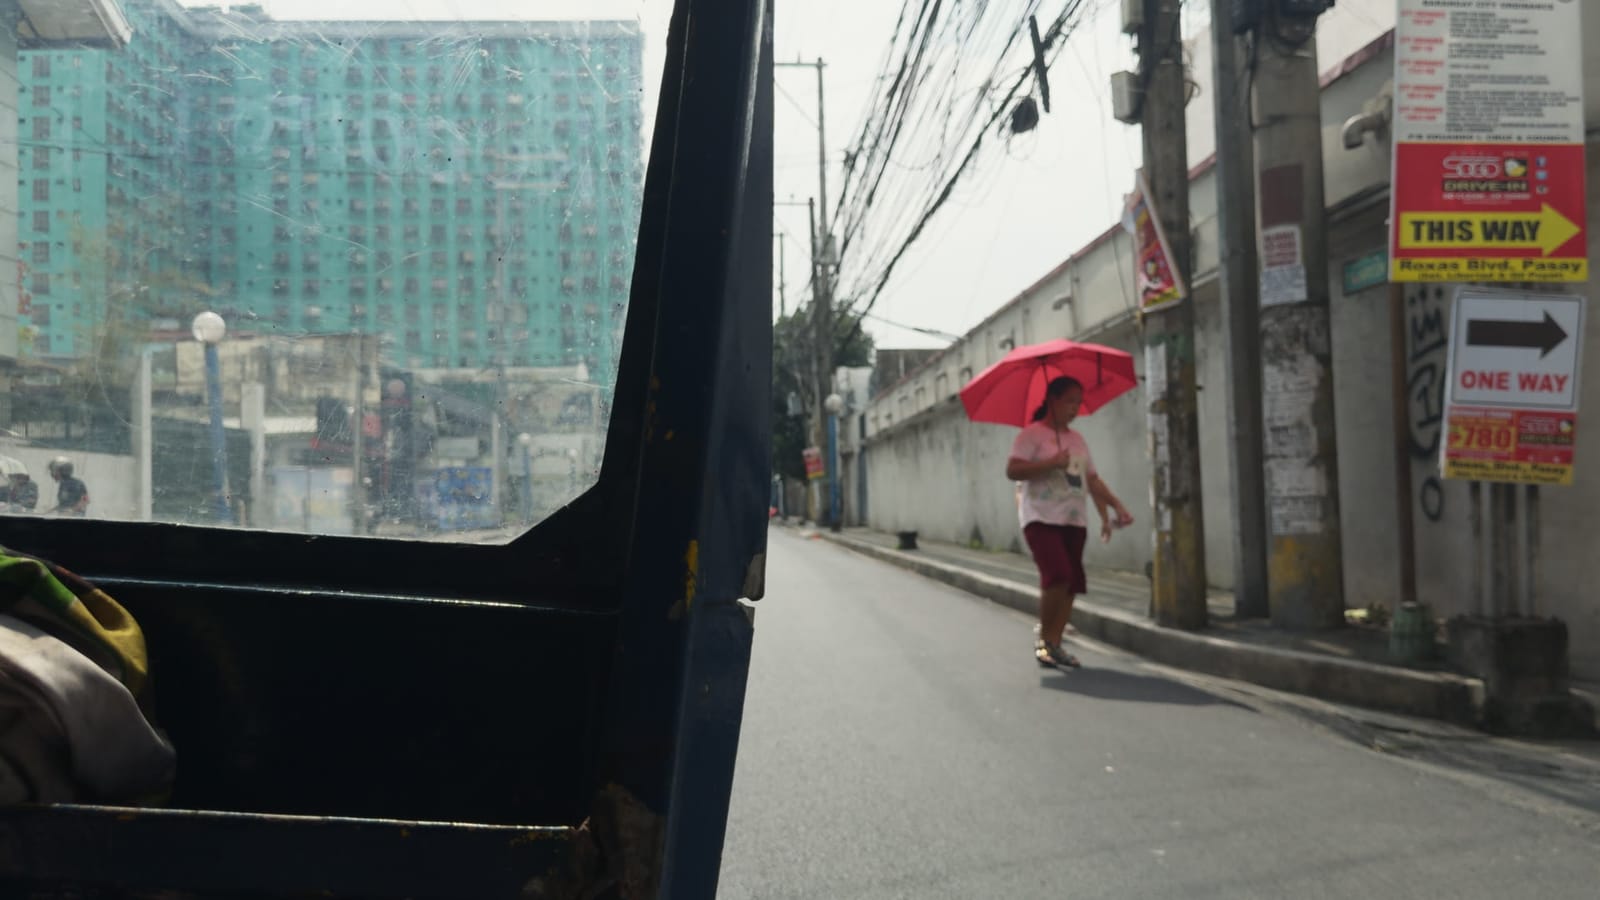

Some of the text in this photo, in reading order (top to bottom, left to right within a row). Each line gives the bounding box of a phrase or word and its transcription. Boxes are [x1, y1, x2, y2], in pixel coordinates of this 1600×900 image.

[1443, 181, 1528, 192] DRIVE-IN
[1410, 219, 1542, 242] THIS WAY
[1399, 259, 1460, 271] Roxas
[1521, 259, 1582, 273] Pasay
[1460, 369, 1569, 394] ONE WAY
